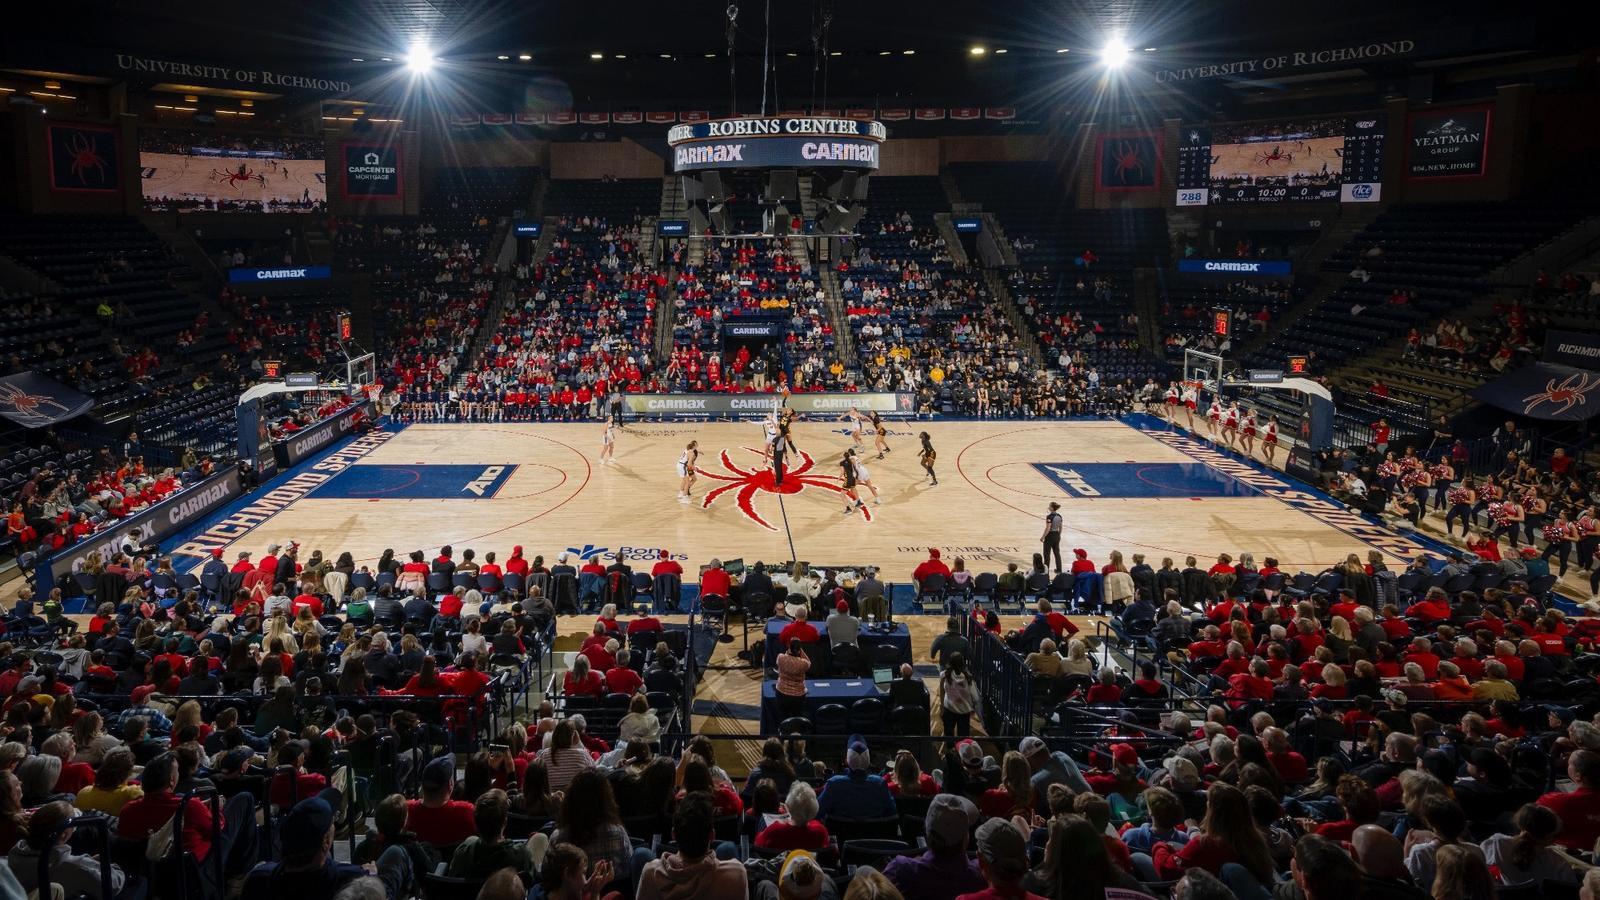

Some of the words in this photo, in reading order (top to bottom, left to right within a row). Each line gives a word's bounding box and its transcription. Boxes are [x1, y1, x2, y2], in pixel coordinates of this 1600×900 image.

[1155, 59, 1259, 83] UNIVERSITY
[1262, 56, 1288, 70] OF
[1293, 39, 1415, 66] RICHMOND
[117, 53, 232, 81] UNIVERSITY
[235, 69, 257, 83] OF
[262, 71, 351, 93] RICHMOND
[708, 119, 780, 136] ROBINS
[785, 118, 860, 135] CENTER
[1414, 132, 1480, 147] YEATMAN
[1430, 147, 1460, 155] GROUP
[348, 166, 396, 174] CAPCENTER
[1181, 193, 1201, 201] 288
[1258, 188, 1286, 197] 10:00
[1300, 187, 1308, 196] 0
[313, 431, 396, 472] SPIDERS
[1142, 429, 1292, 488] RICHMOND
[171, 472, 331, 560] RICHMOND
